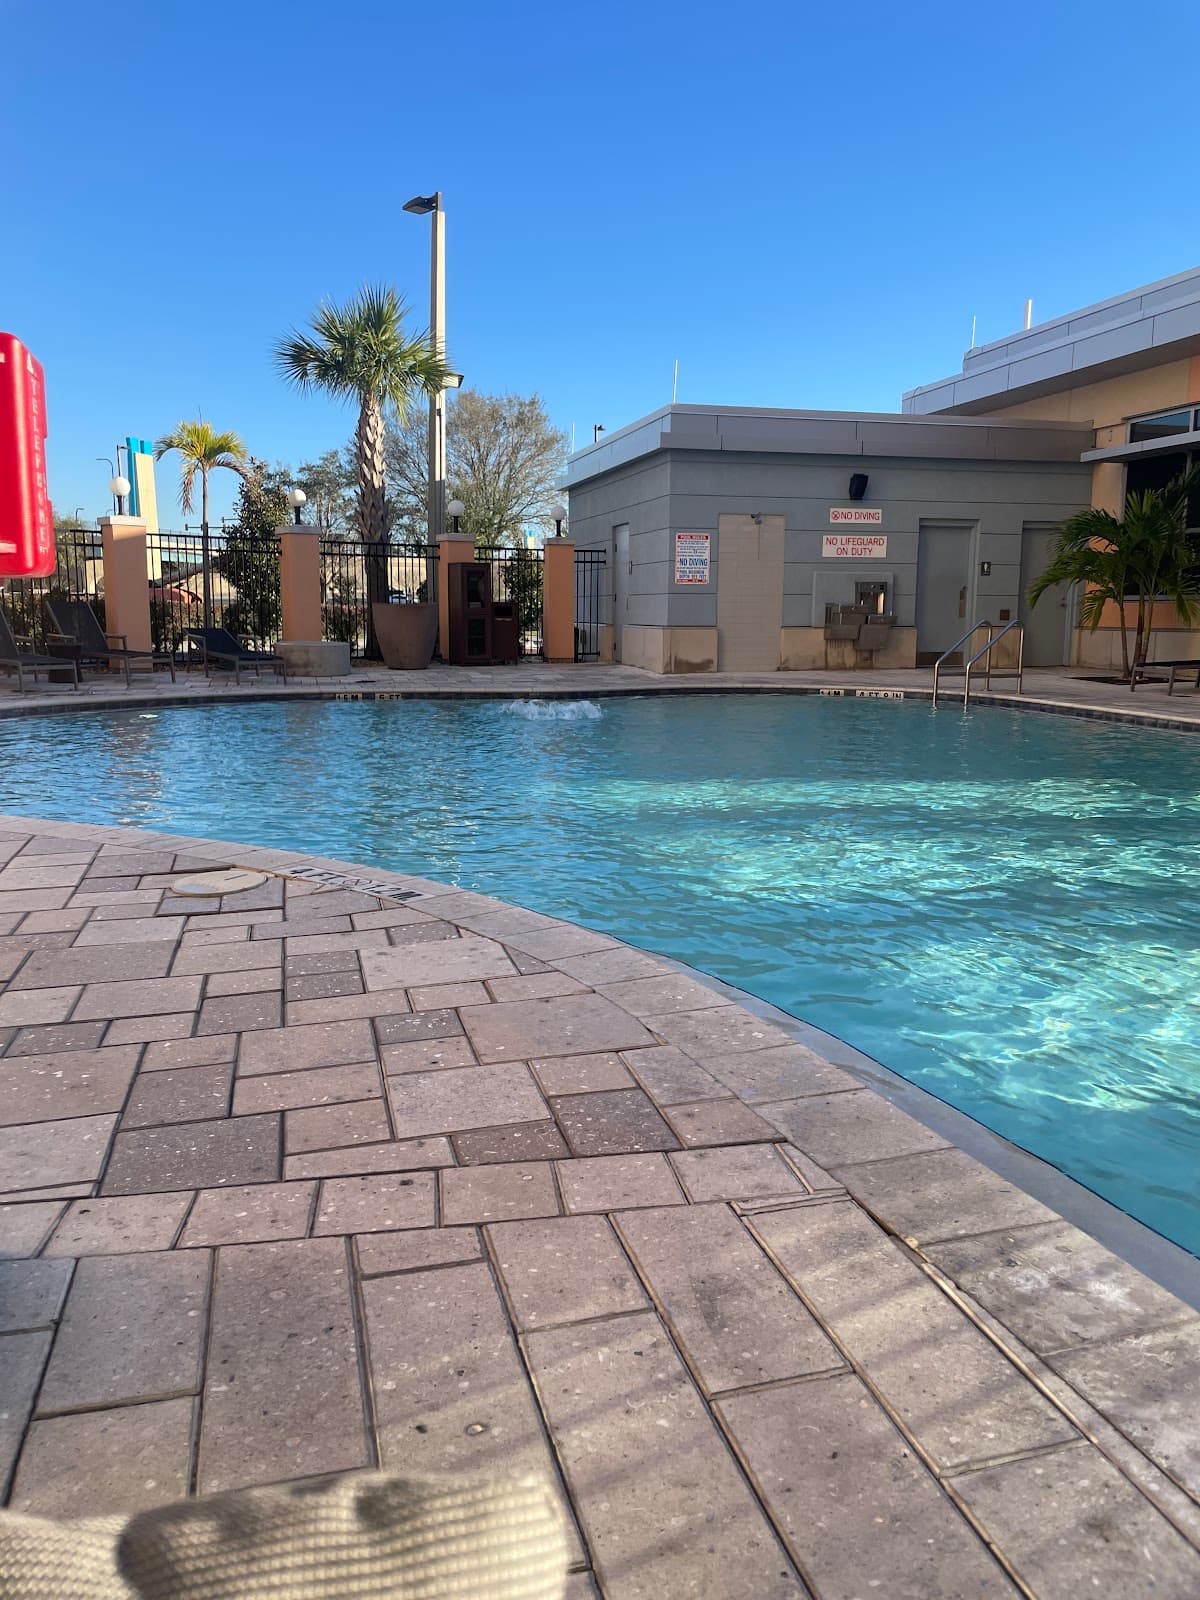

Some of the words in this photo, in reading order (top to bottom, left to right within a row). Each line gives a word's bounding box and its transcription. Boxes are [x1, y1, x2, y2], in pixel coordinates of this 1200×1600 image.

[841, 511, 853, 520] NO
[855, 512, 880, 521] DIVING
[826, 537, 838, 546] NO
[840, 537, 885, 546] LIFEGUARD
[836, 547, 849, 556] ON
[851, 547, 873, 556] DUTY
[680, 558, 687, 566] NO
[689, 558, 708, 566] DIVING
